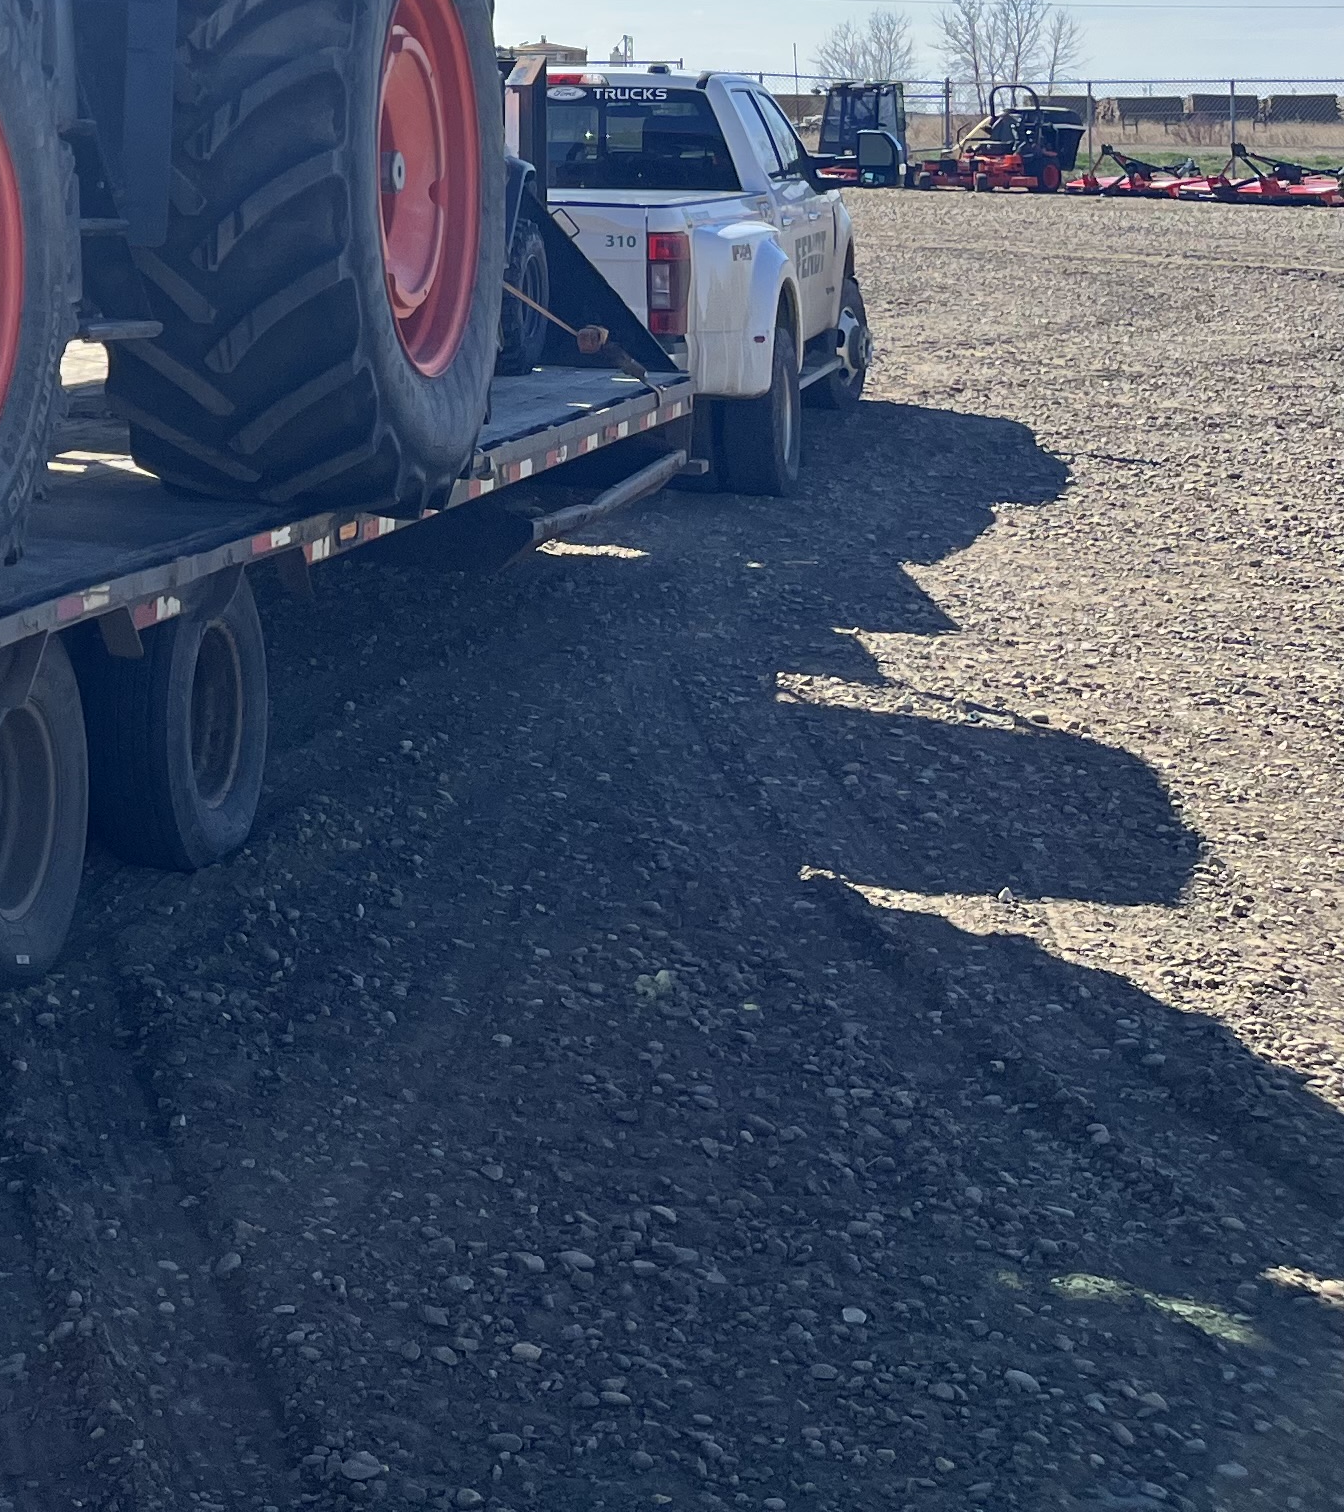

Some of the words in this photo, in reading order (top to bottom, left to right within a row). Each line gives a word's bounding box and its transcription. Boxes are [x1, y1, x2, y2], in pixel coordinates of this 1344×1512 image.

[592, 88, 668, 100] TRUCKS
[605, 234, 637, 248] 310
[795, 230, 827, 281] FENDT
